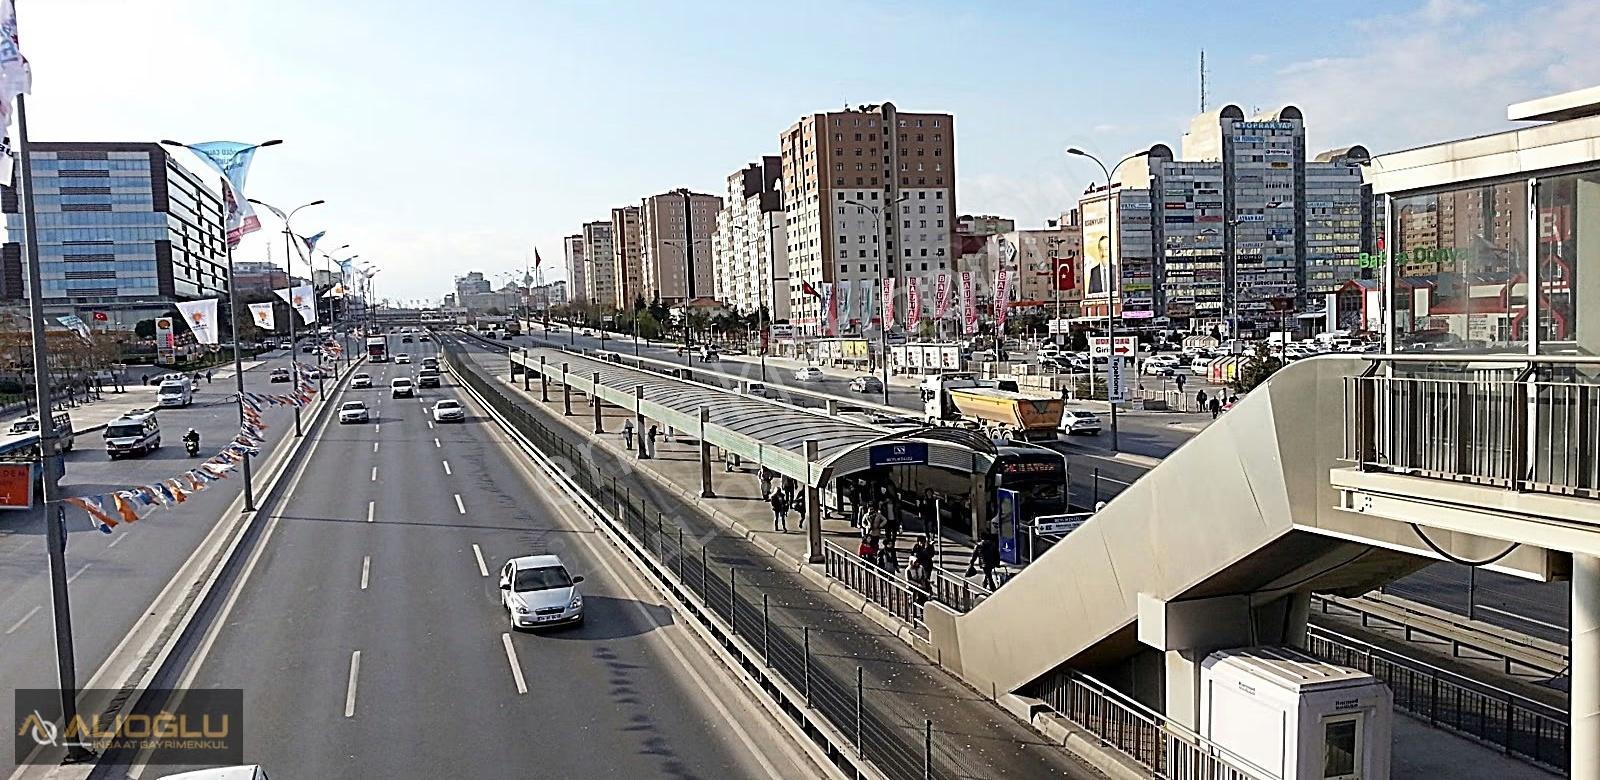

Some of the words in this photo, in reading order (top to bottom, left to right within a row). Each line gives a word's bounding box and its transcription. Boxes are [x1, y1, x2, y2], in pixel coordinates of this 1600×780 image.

[1360, 250, 1408, 268] Bahe
[962, 272, 973, 335] BAUHAUS
[1112, 357, 1120, 396] TepeHome
